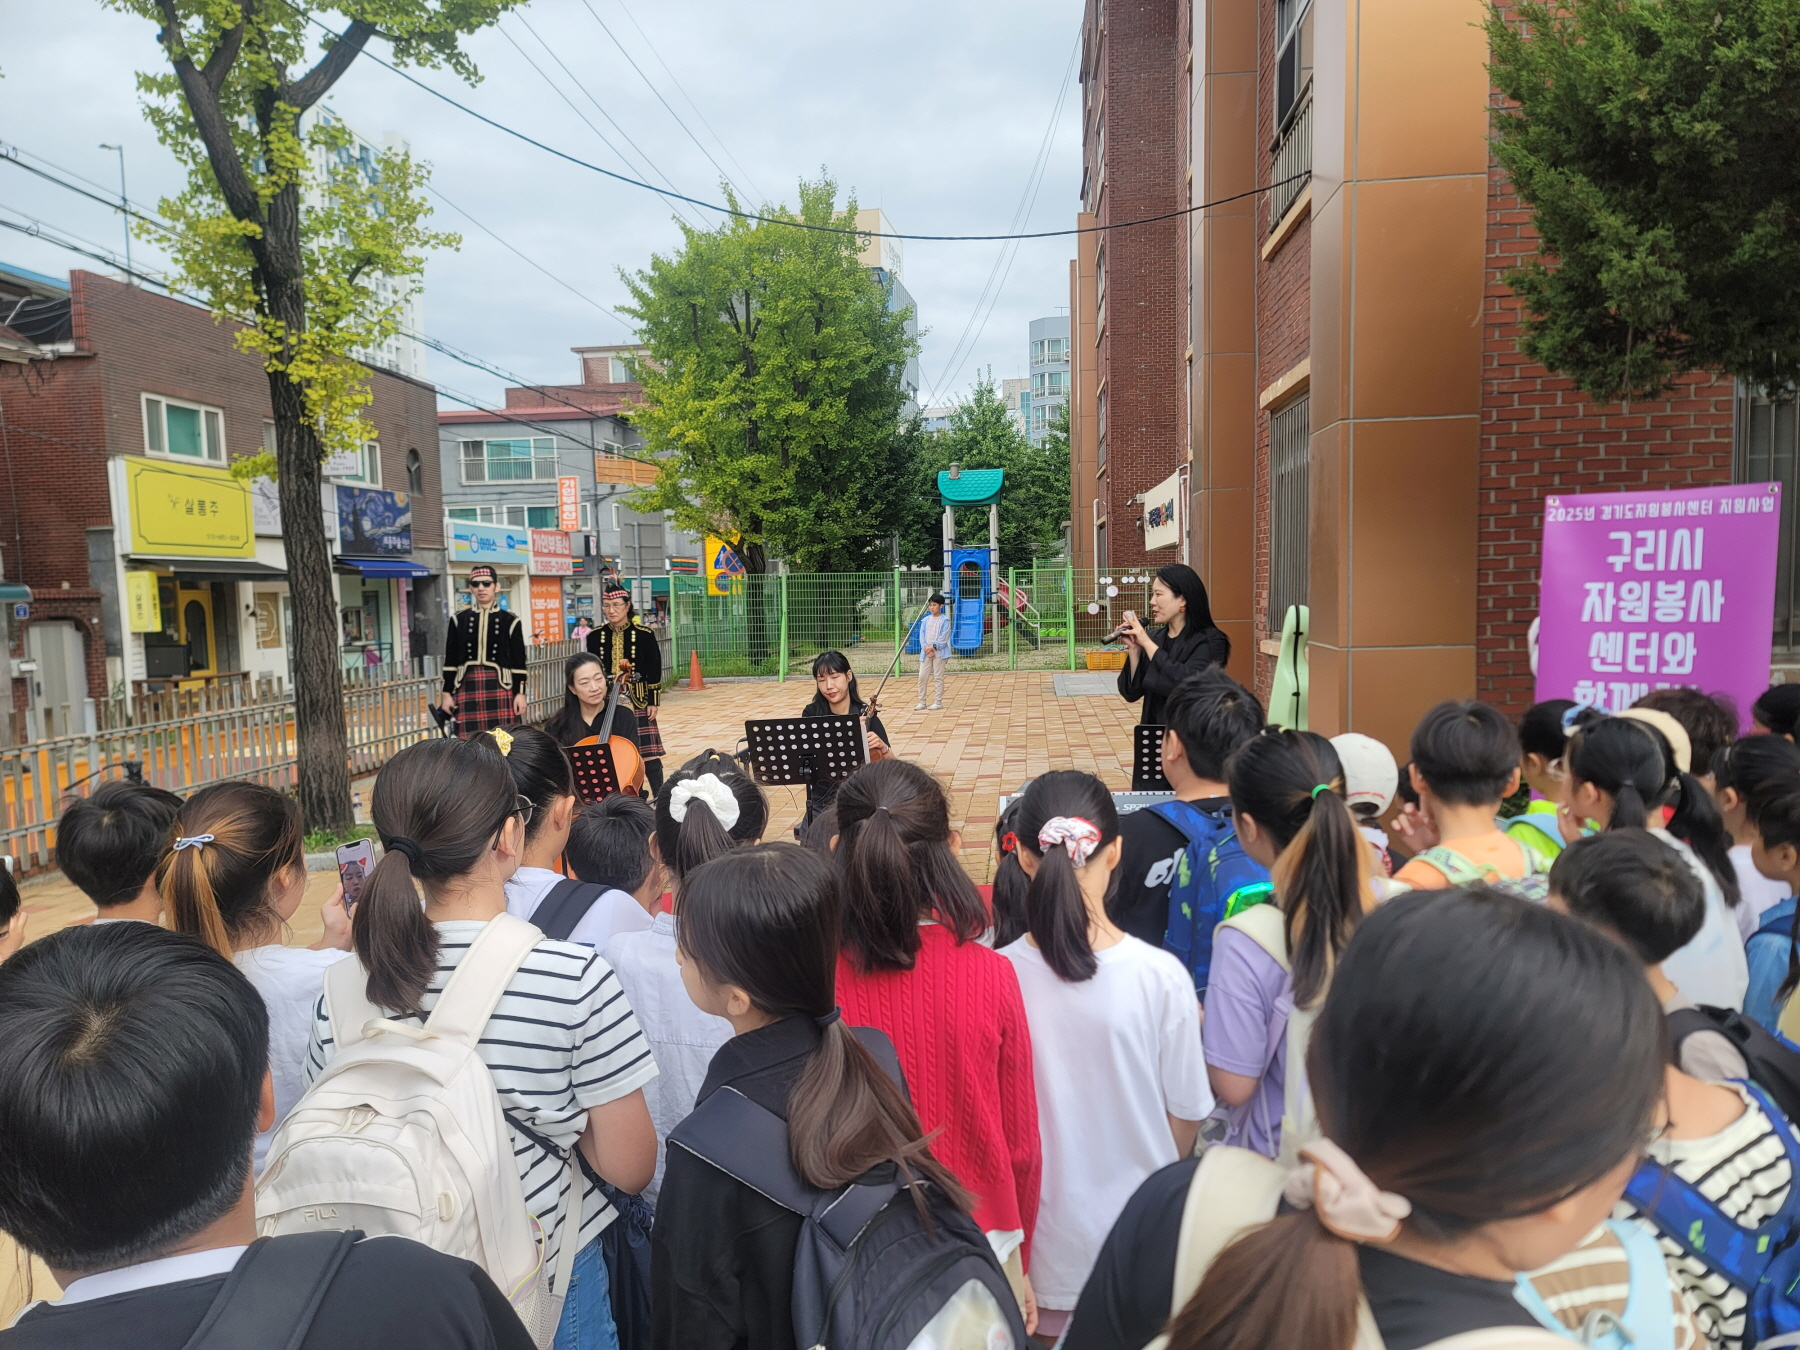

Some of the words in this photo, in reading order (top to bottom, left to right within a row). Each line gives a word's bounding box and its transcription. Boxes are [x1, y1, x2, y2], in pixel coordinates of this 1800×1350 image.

[561, 479, 576, 519] 가인부동산
[1547, 506, 1596, 522] 2025년
[1600, 499, 1713, 520] 경기도자원봉사센터
[1719, 496, 1774, 514] 지원사업
[533, 533, 570, 555] 가인부동산
[1606, 527, 1704, 573] 구리시
[1580, 579, 1725, 622] 자원봉사
[1588, 631, 1697, 674] 센터와
[304, 1207, 339, 1222] FILA
